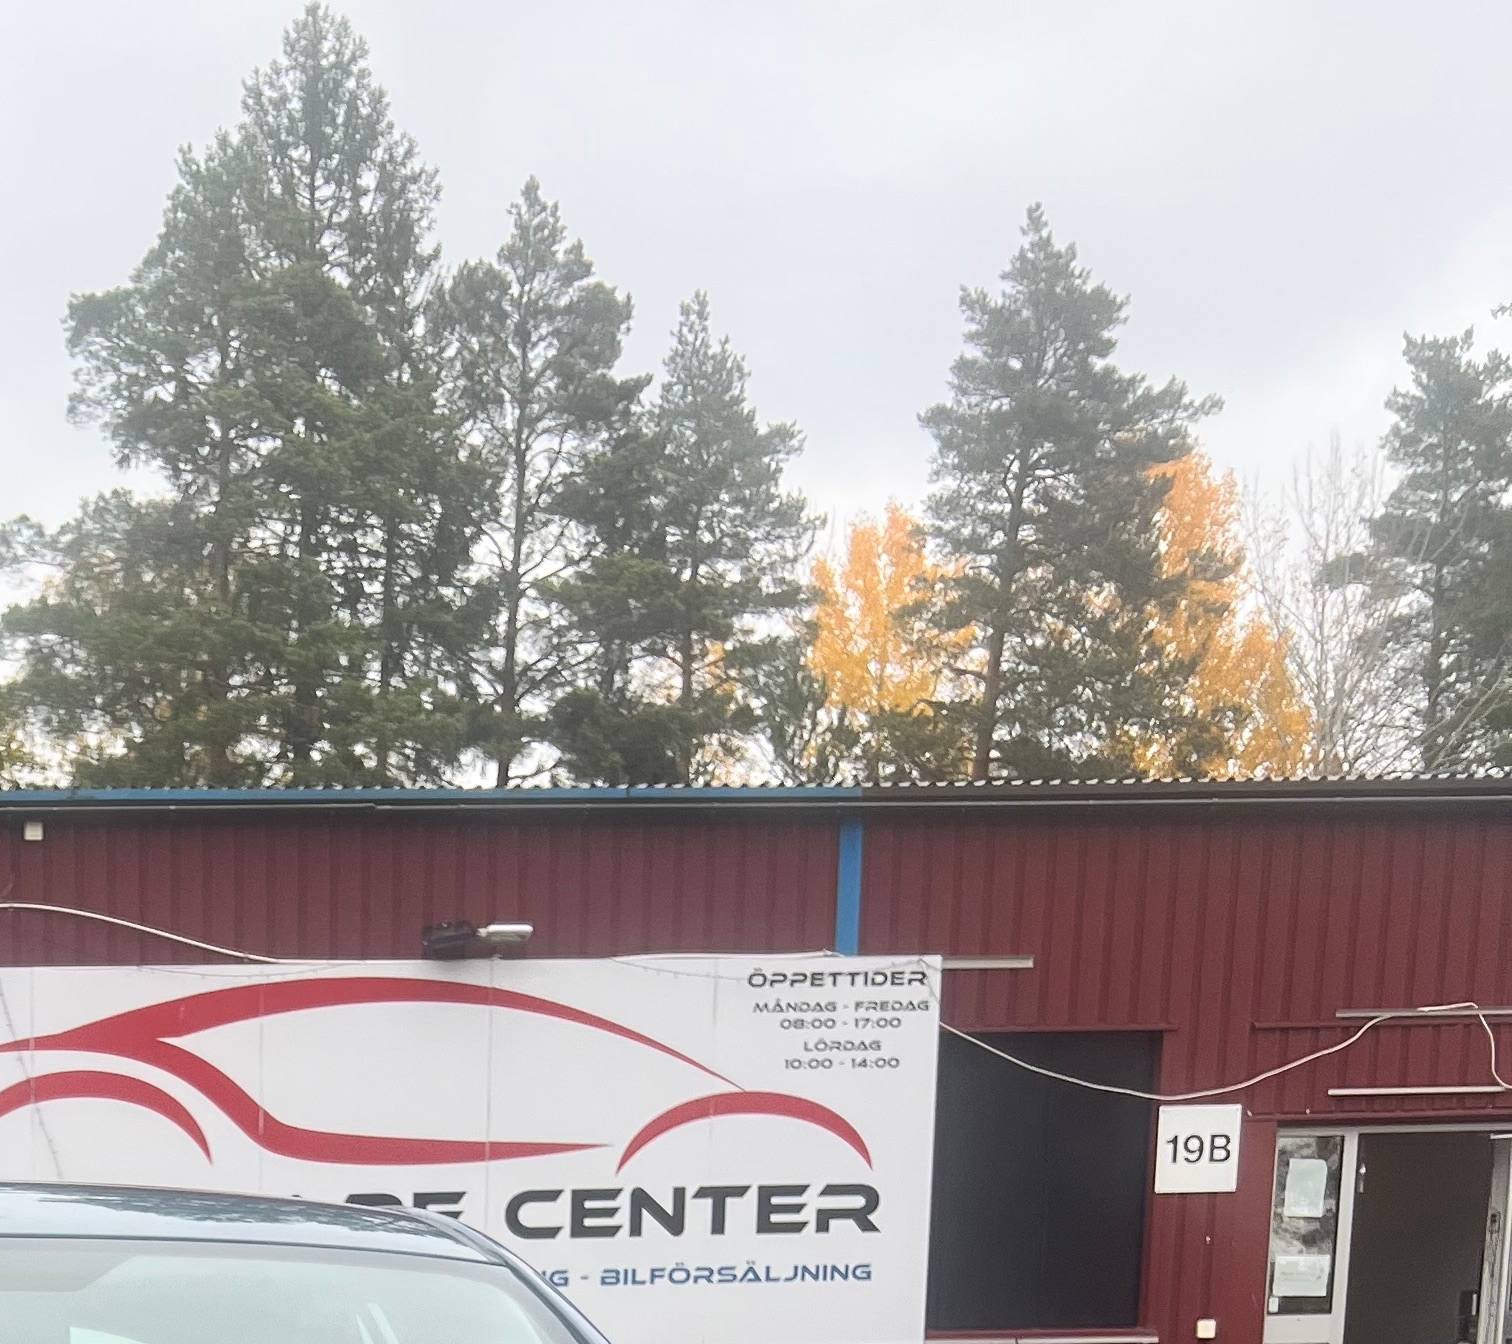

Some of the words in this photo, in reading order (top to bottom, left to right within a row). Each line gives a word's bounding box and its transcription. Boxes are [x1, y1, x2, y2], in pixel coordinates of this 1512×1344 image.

[747, 967, 927, 988] ÖPPETTIDER
[752, 997, 837, 1014] MÅNDAG
[854, 999, 930, 1013] FREDAG
[779, 1017, 836, 1030] 08:00
[854, 1016, 902, 1030] 17:00
[803, 1036, 882, 1053] LÖRDAG
[784, 1057, 834, 1070] 10:00
[851, 1056, 901, 1069] 14:00
[1166, 1134, 1231, 1164] 19B
[505, 1183, 881, 1240] CENTER
[600, 1260, 872, 1286] BILFÖRSÄLJNING
